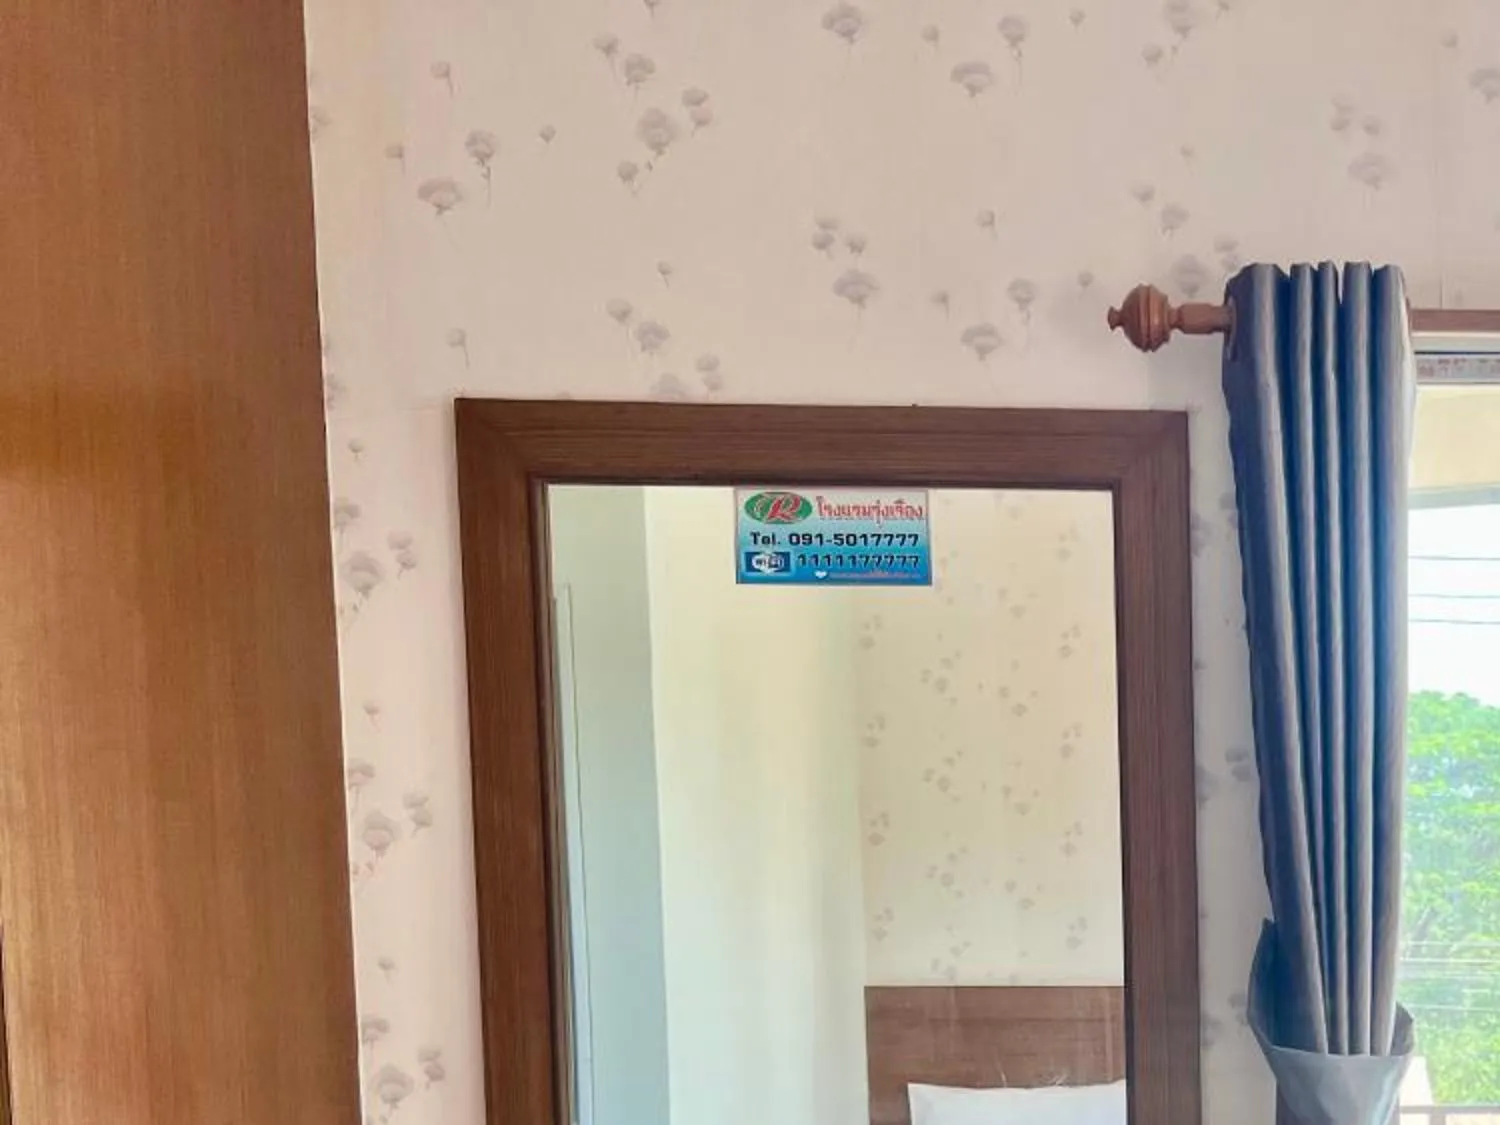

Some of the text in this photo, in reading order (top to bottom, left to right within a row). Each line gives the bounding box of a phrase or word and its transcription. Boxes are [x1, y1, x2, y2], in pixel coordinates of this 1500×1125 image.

[751, 532, 919, 546] Tel. 091-5017777
[797, 554, 919, 567] 1111177777
